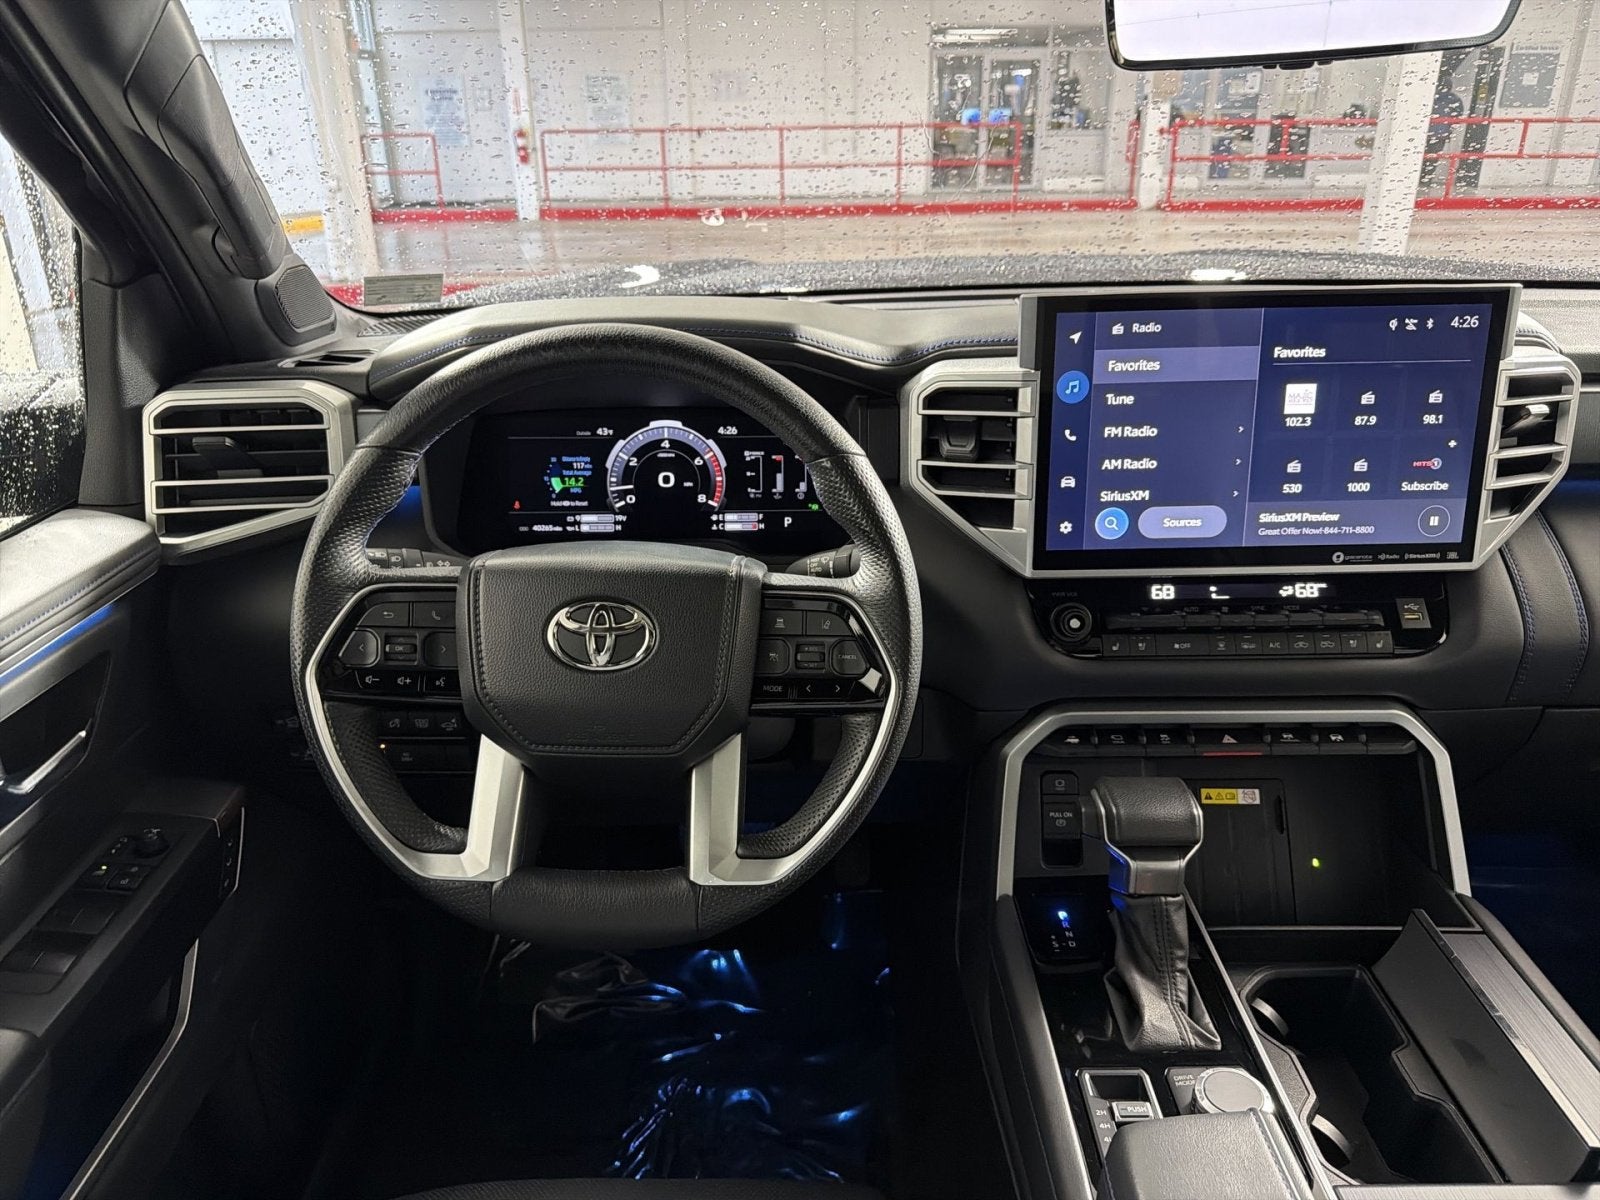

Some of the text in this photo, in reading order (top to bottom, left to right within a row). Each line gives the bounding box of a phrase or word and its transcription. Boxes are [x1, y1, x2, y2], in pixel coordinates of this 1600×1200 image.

[1451, 315, 1480, 328] 4:26
[1132, 322, 1162, 333] Radio
[1273, 346, 1326, 359] Favorites
[1108, 359, 1161, 372] Favorites
[1105, 393, 1135, 405] Tune
[1285, 416, 1312, 427] 102.3
[1354, 415, 1377, 426] 87.9
[1423, 414, 1444, 425] 98.1
[718, 426, 738, 435] 4:26
[1104, 425, 1158, 438] FM Radio
[660, 440, 670, 448] 4
[628, 457, 638, 466] 2
[694, 457, 704, 466] 6
[1101, 458, 1158, 470] AM Radio
[564, 477, 584, 487] 14.2
[658, 472, 675, 488] 0
[1282, 483, 1303, 494] 530
[1347, 482, 1371, 493] 1000
[1401, 481, 1449, 492] Subscribe
[626, 494, 636, 504] 0
[697, 494, 707, 503] 8
[1100, 489, 1150, 502] SiriusXM
[784, 516, 792, 528] P
[1162, 517, 1202, 528] Sources
[1259, 512, 1341, 523] SiriusXM Preview
[1258, 527, 1280, 536] Great
[1281, 527, 1301, 535] Offer
[1150, 584, 1175, 600] 68
[1294, 583, 1319, 598] 68
